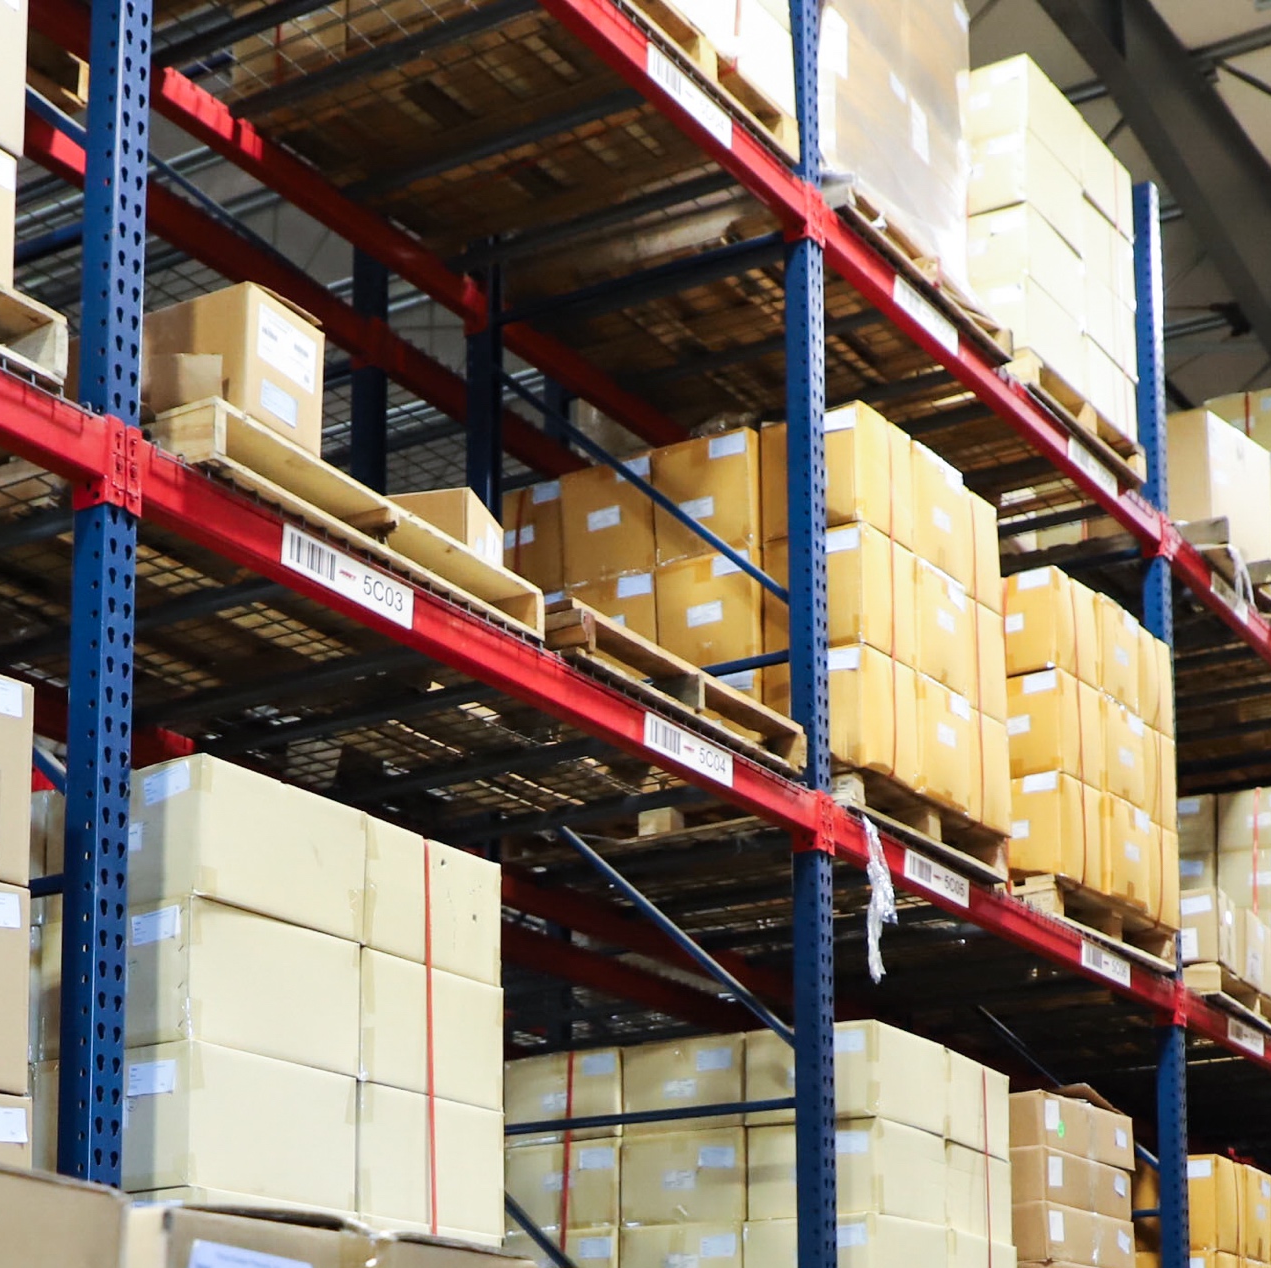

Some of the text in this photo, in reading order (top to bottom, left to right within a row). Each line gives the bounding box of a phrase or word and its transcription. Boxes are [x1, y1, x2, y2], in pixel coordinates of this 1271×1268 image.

[363, 575, 403, 612] 5C03
[699, 747, 726, 773] 5C04
[945, 875, 965, 898] 5C05
